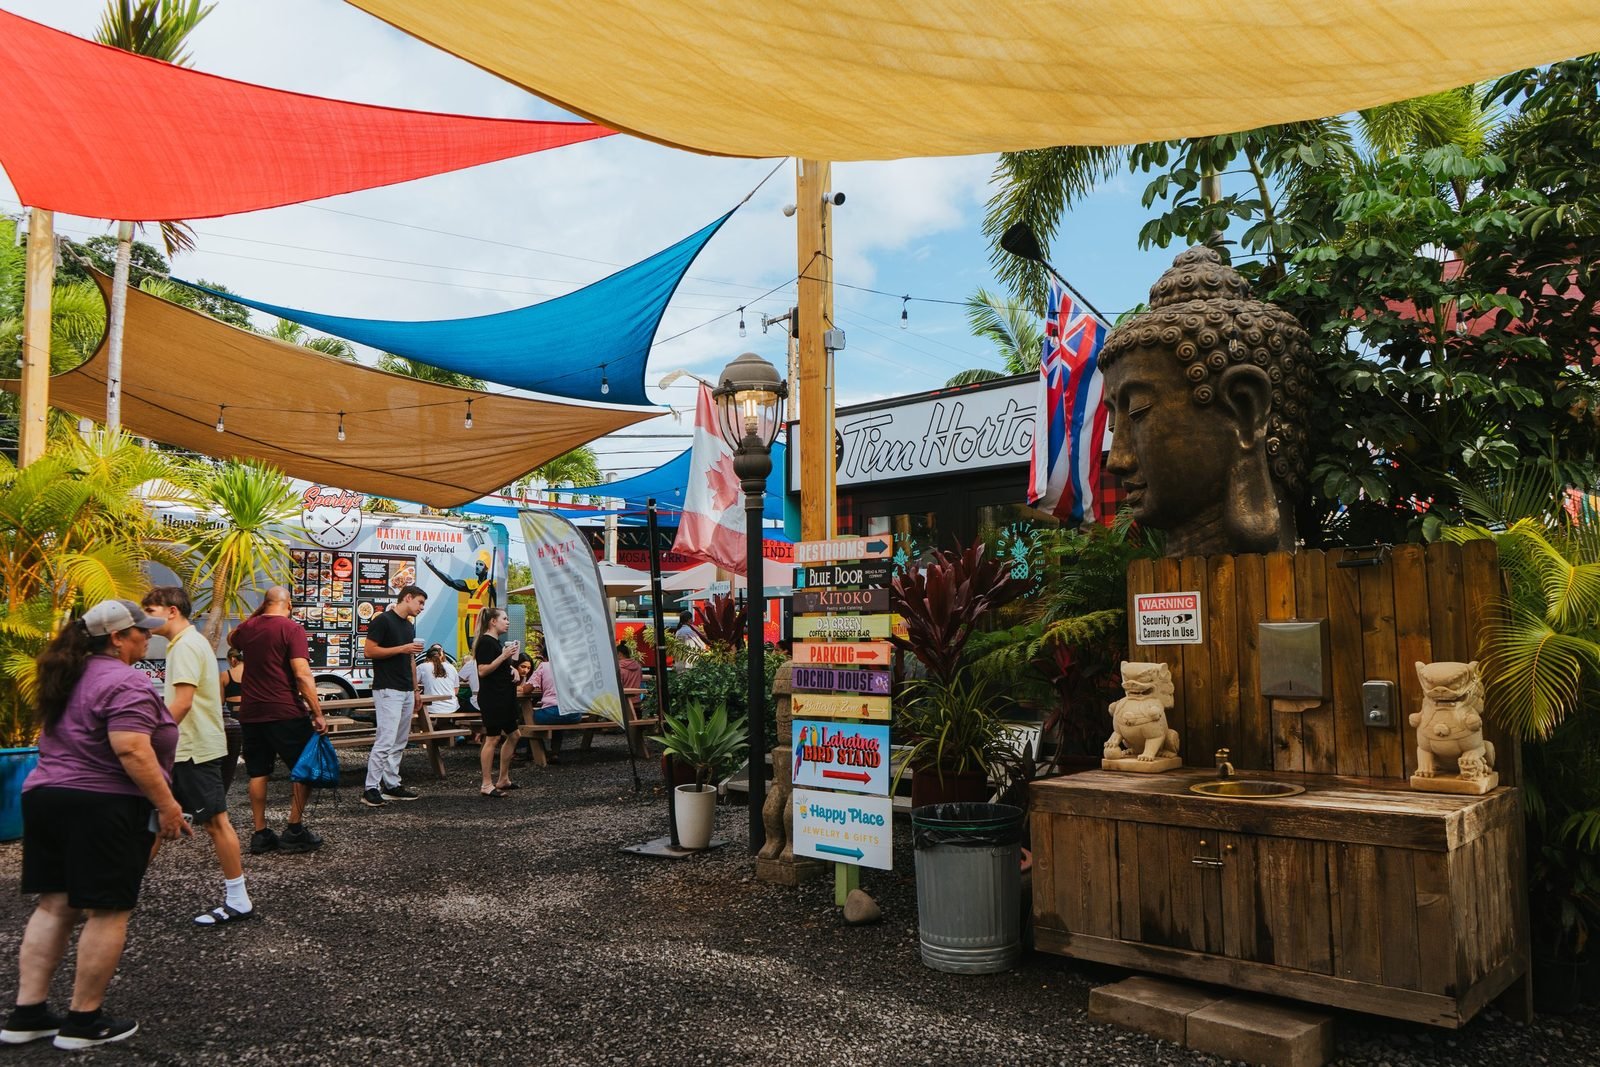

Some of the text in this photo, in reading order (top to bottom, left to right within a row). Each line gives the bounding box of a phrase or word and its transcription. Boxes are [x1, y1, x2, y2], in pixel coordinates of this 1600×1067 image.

[843, 399, 1037, 478] Tim Horto
[304, 486, 364, 514] Sparky's
[376, 527, 463, 543] NATIVE HAWAIIAN
[381, 541, 455, 554] Owned and Operated
[799, 541, 865, 562] RESTROOMS
[810, 567, 863, 586] BLUE DOOR
[820, 592, 872, 605] KITOKO
[1141, 598, 1194, 610] WARNING
[831, 617, 863, 629] GREEN
[1142, 615, 1171, 627] Security
[833, 630, 856, 638] DESSERT
[1143, 628, 1171, 638] Cameras
[1181, 627, 1195, 637] Use
[810, 646, 855, 664] PARKING
[796, 669, 874, 691] ORCHID HOUSE
[822, 726, 879, 751] Lahaina
[803, 745, 881, 768] BIRD STAND
[809, 804, 885, 827] Happy Place
[803, 826, 840, 839] JEWELRY
[853, 833, 880, 845] GIFTS
